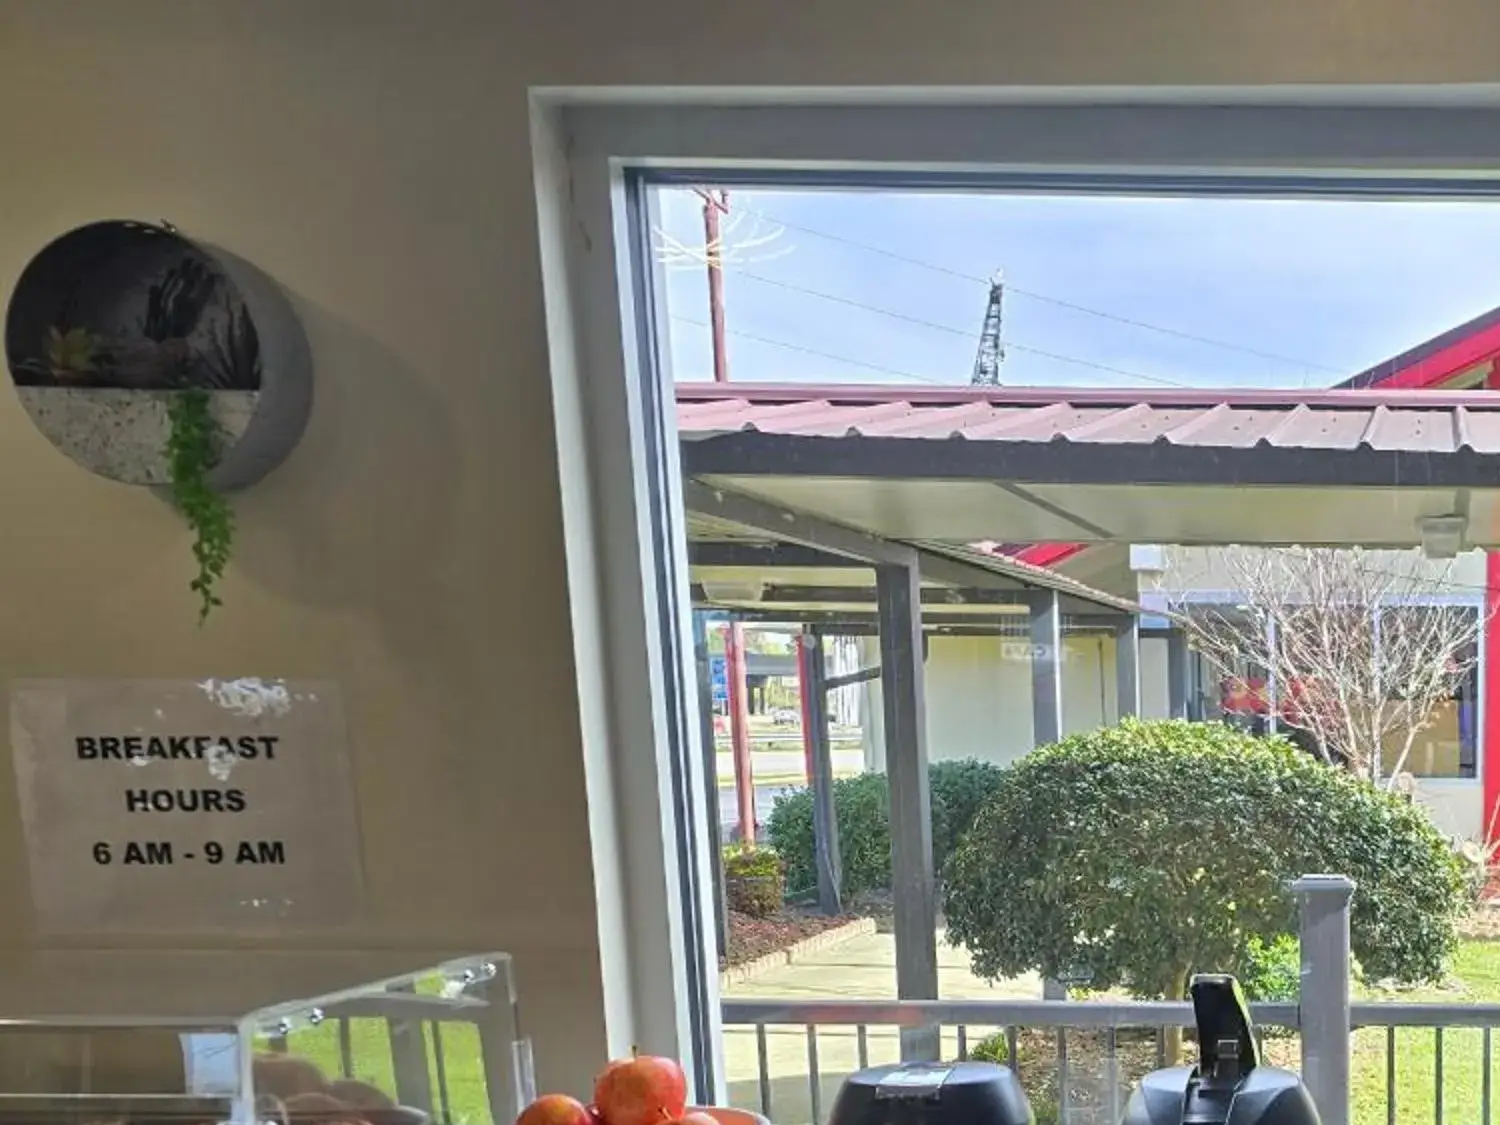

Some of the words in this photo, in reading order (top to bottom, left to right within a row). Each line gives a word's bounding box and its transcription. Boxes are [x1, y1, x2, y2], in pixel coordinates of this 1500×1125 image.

[125, 789, 247, 812] HOURS
[92, 842, 112, 865] 6
[123, 842, 173, 865] AM
[203, 842, 224, 865] 9
[235, 842, 286, 865] AM
